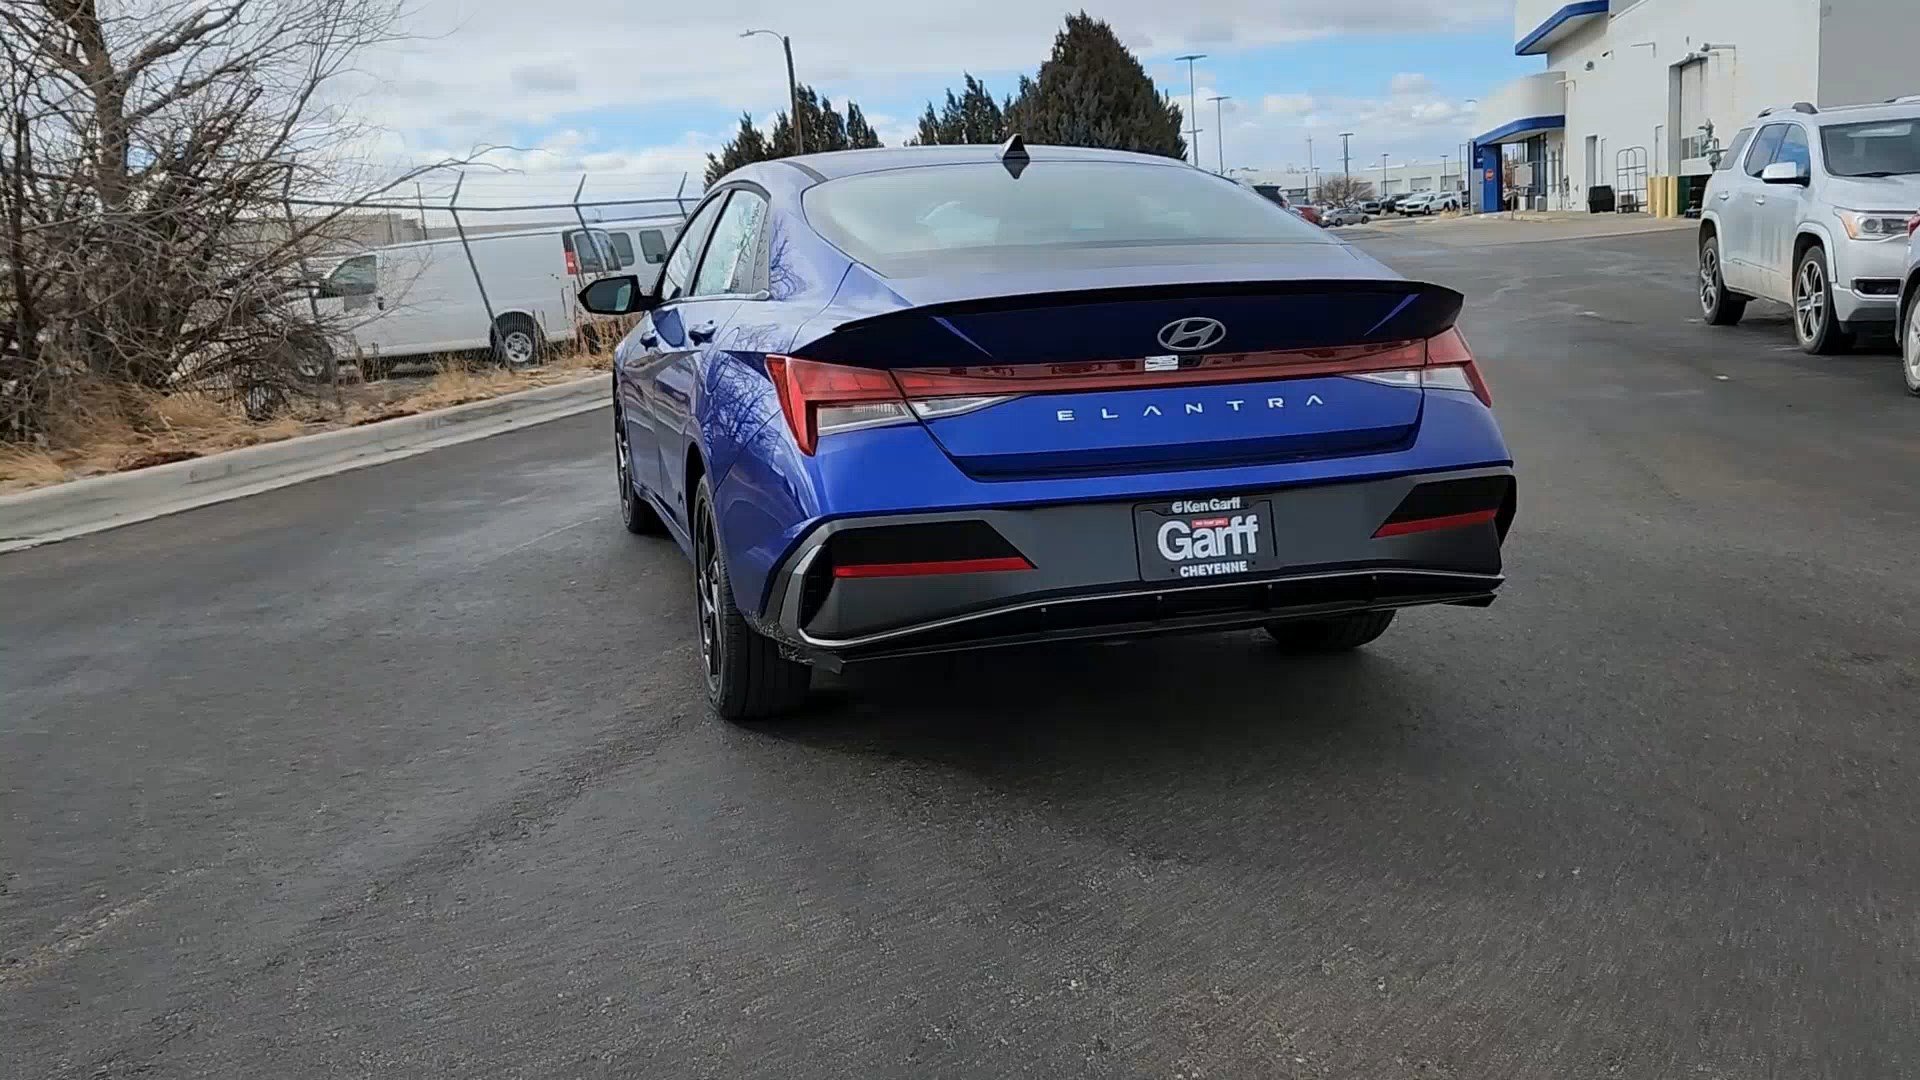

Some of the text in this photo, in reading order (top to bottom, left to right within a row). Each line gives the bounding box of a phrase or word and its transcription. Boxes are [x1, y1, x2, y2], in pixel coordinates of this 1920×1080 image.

[1057, 395, 1323, 421] ELANTRA
[1183, 496, 1241, 513] Ken Garff
[1157, 514, 1259, 561] Garff
[1179, 560, 1248, 577] CHEYENNE
